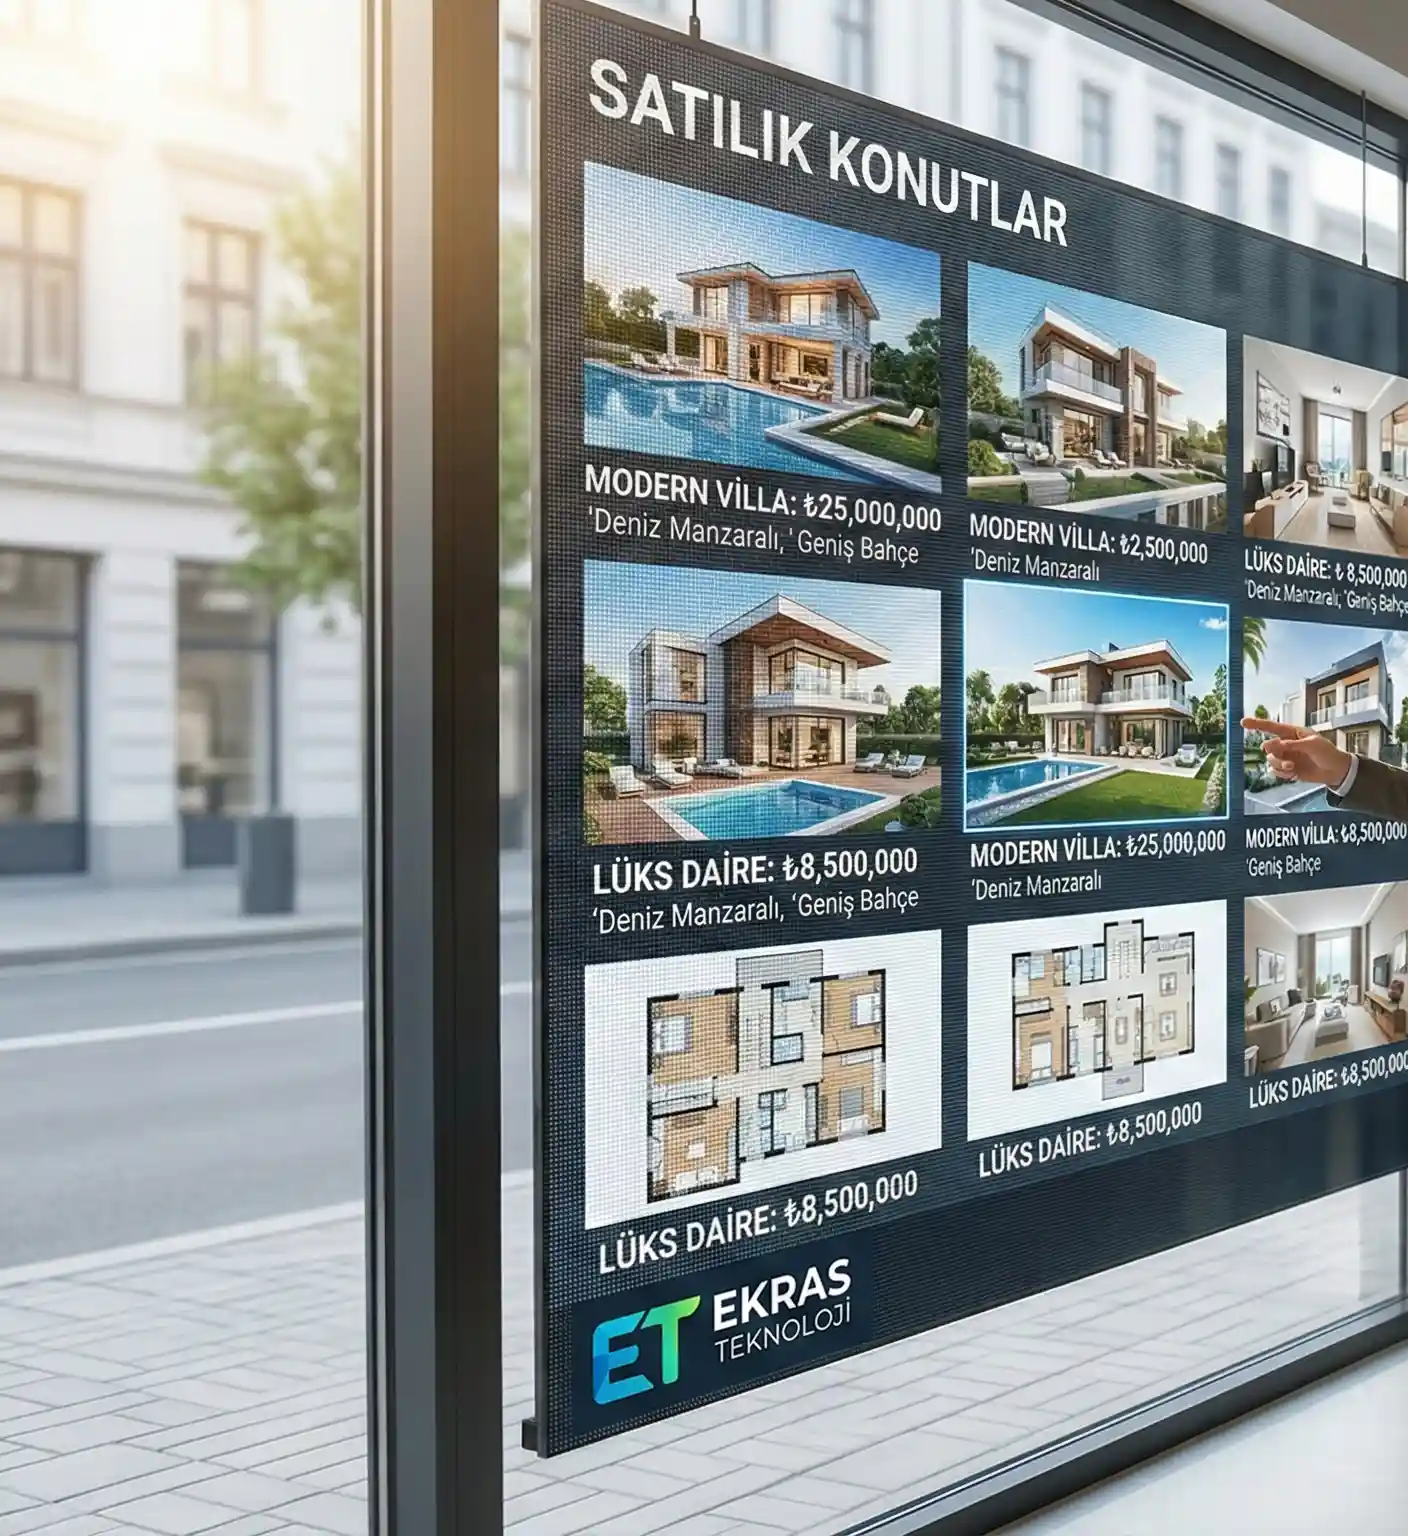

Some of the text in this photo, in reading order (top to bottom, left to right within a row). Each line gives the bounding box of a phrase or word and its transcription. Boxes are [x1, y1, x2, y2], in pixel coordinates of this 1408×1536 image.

[589, 59, 1068, 247] SATILIK KONUTLAR
[585, 463, 942, 533] MODERN VİLLA: ₺25,000,000
[861, 536, 919, 568] Bahçe
[970, 513, 1208, 565] MODERN VİLLA: ₺2,500,000
[1025, 554, 1100, 581] Manzaralı
[1245, 545, 1282, 573] LÜKS
[1287, 552, 1331, 579] DAİRE:
[1347, 562, 1407, 590] 8,500,000
[970, 829, 1226, 868] MODERN VİLLA: ₺25,000,000
[1246, 821, 1407, 848] MODERN VİLLA: ₺8,500,000
[593, 847, 918, 895] LÜKS DAİRE: ₺8,500,000
[1027, 869, 1101, 897] Manzaralı
[1286, 853, 1321, 877] Bahçe
[672, 895, 784, 928] Manzaralı,
[861, 886, 919, 915] Bahçe
[1250, 1079, 1288, 1108] LÜKS
[1292, 1068, 1338, 1098] DAİRE:
[979, 1101, 1202, 1178] LÜKS DAİRE: ₺8,500,000
[599, 1170, 918, 1275] LÜKS DAİRE: ₺8,500,000
[713, 1258, 851, 1331] EKRAS
[592, 1295, 701, 1405] ET
[714, 1297, 851, 1363] TEKNOLOJİ
